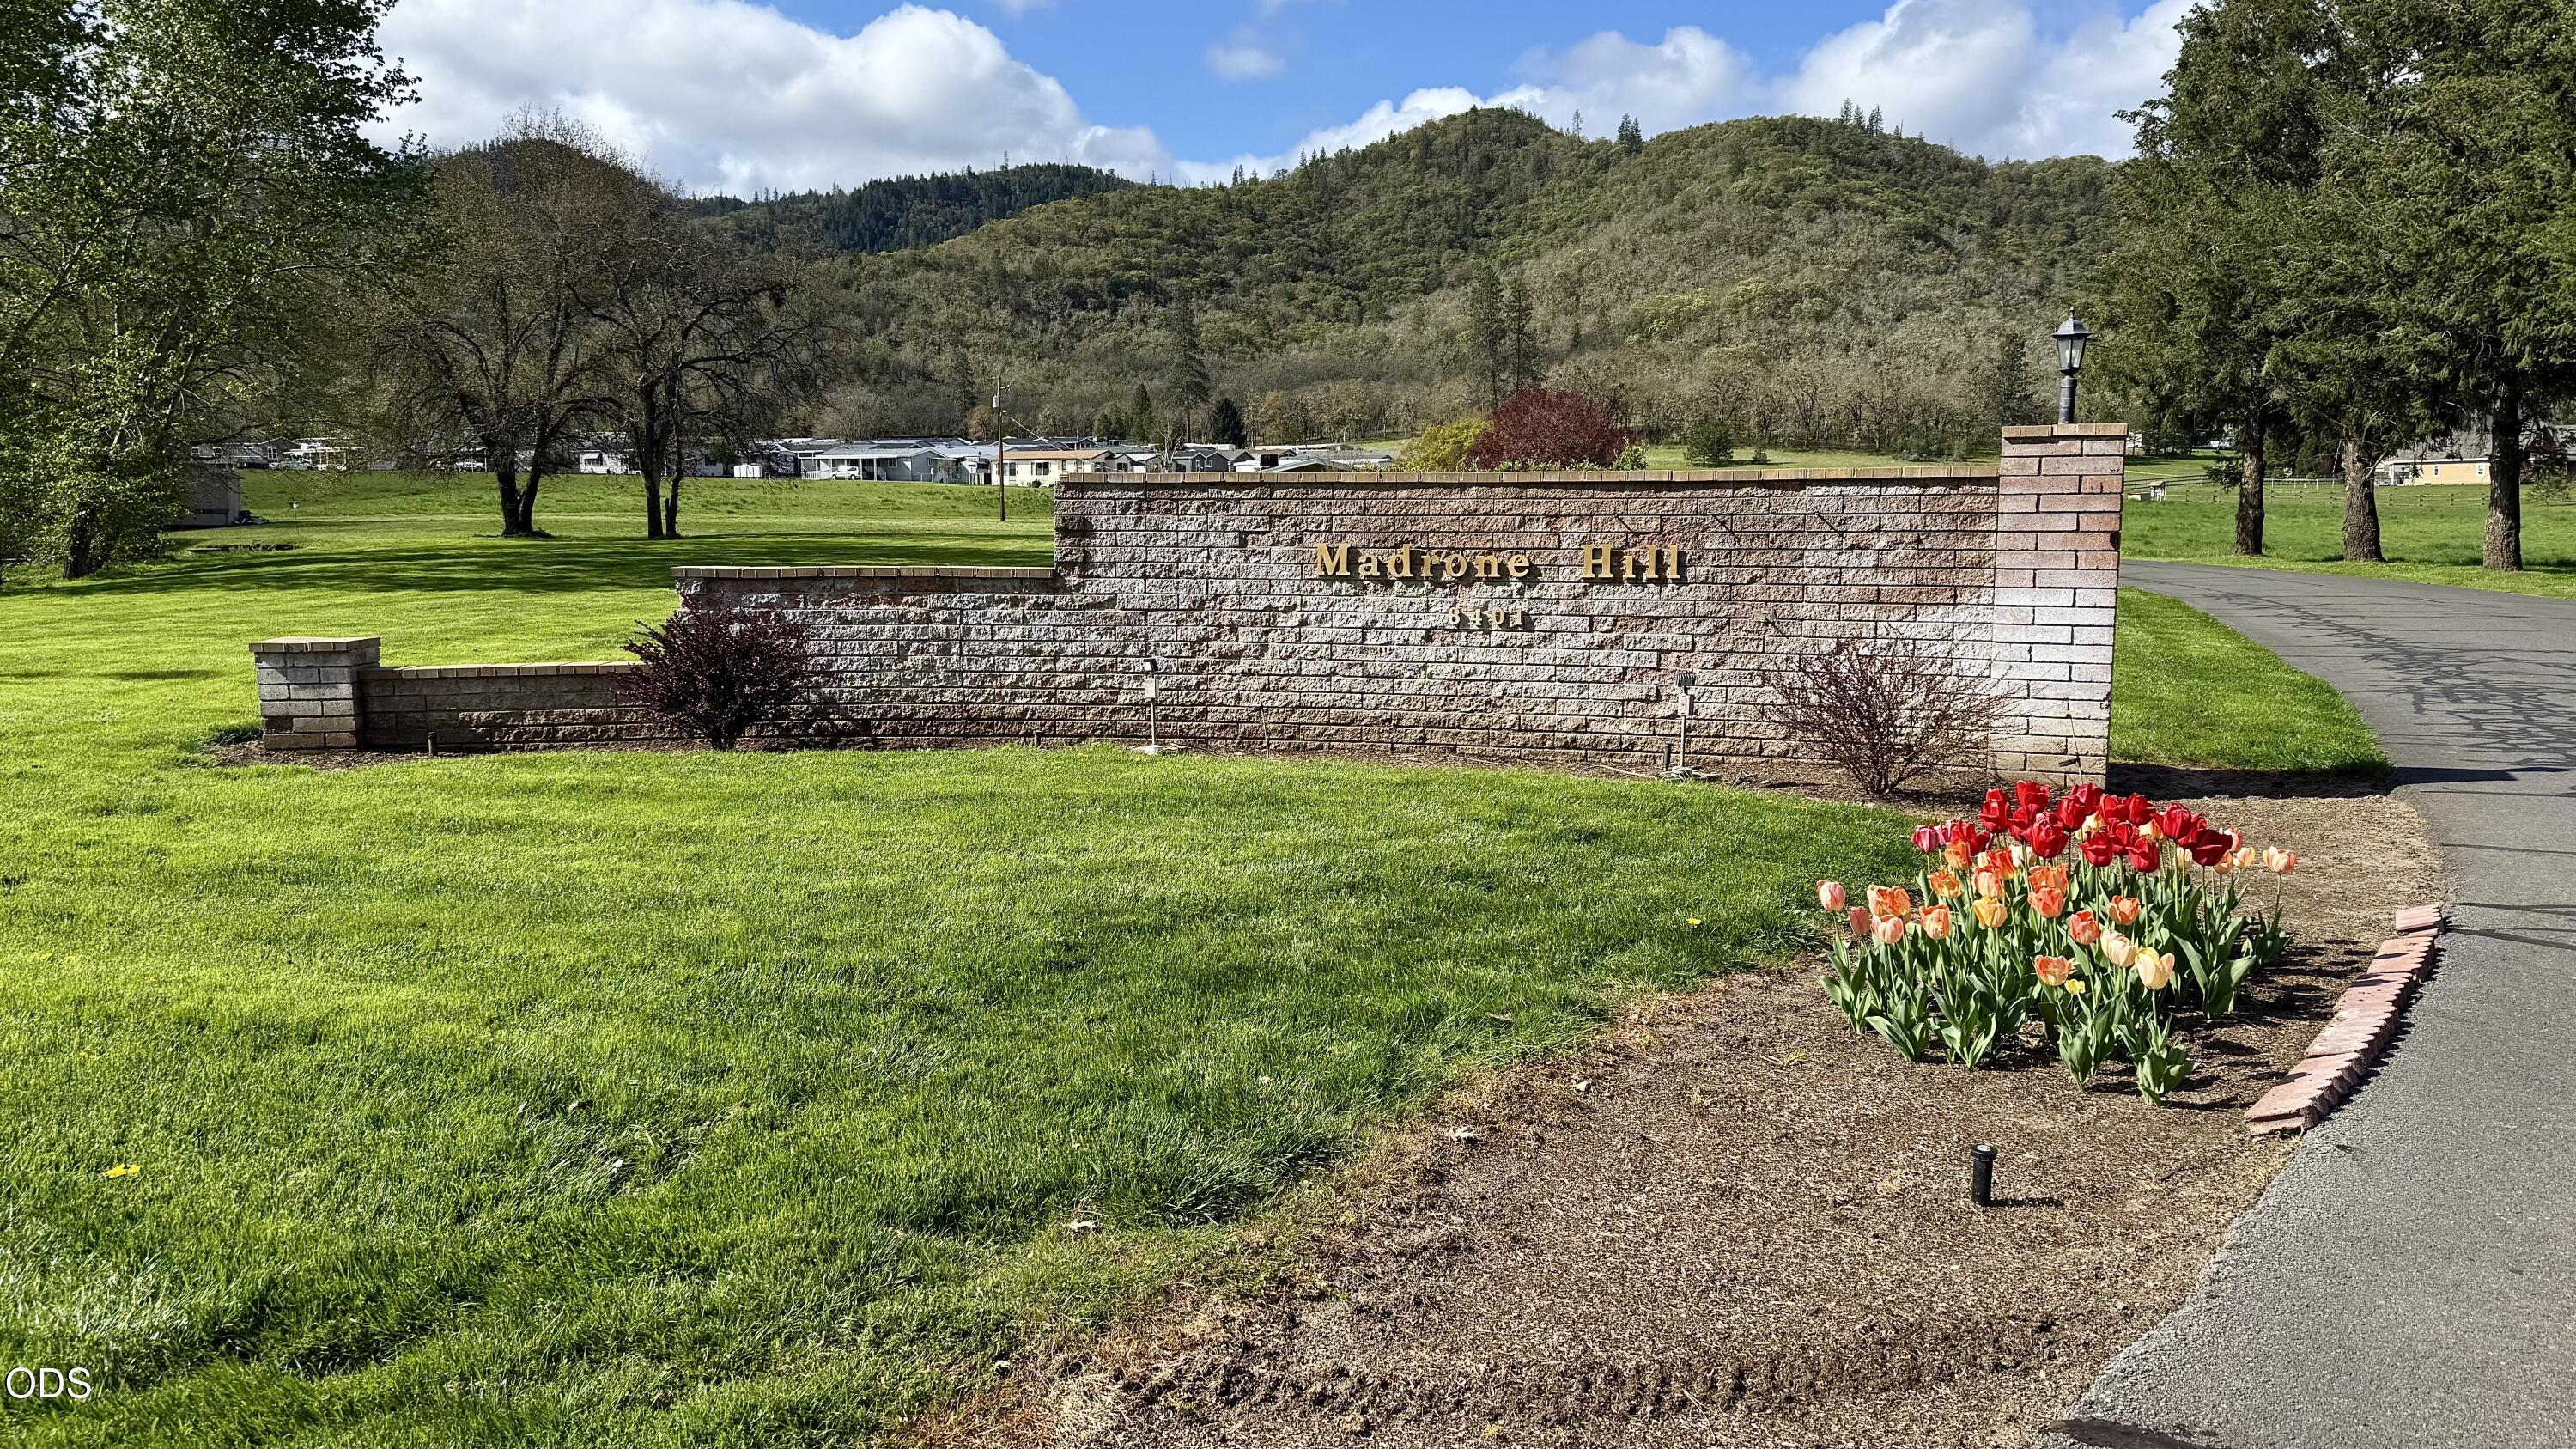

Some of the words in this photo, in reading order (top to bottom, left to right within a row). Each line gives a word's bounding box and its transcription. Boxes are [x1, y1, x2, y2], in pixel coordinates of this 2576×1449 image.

[1316, 543, 1530, 578] Madrone
[1582, 543, 1680, 579] Hill
[1448, 606, 1523, 626] 8401
